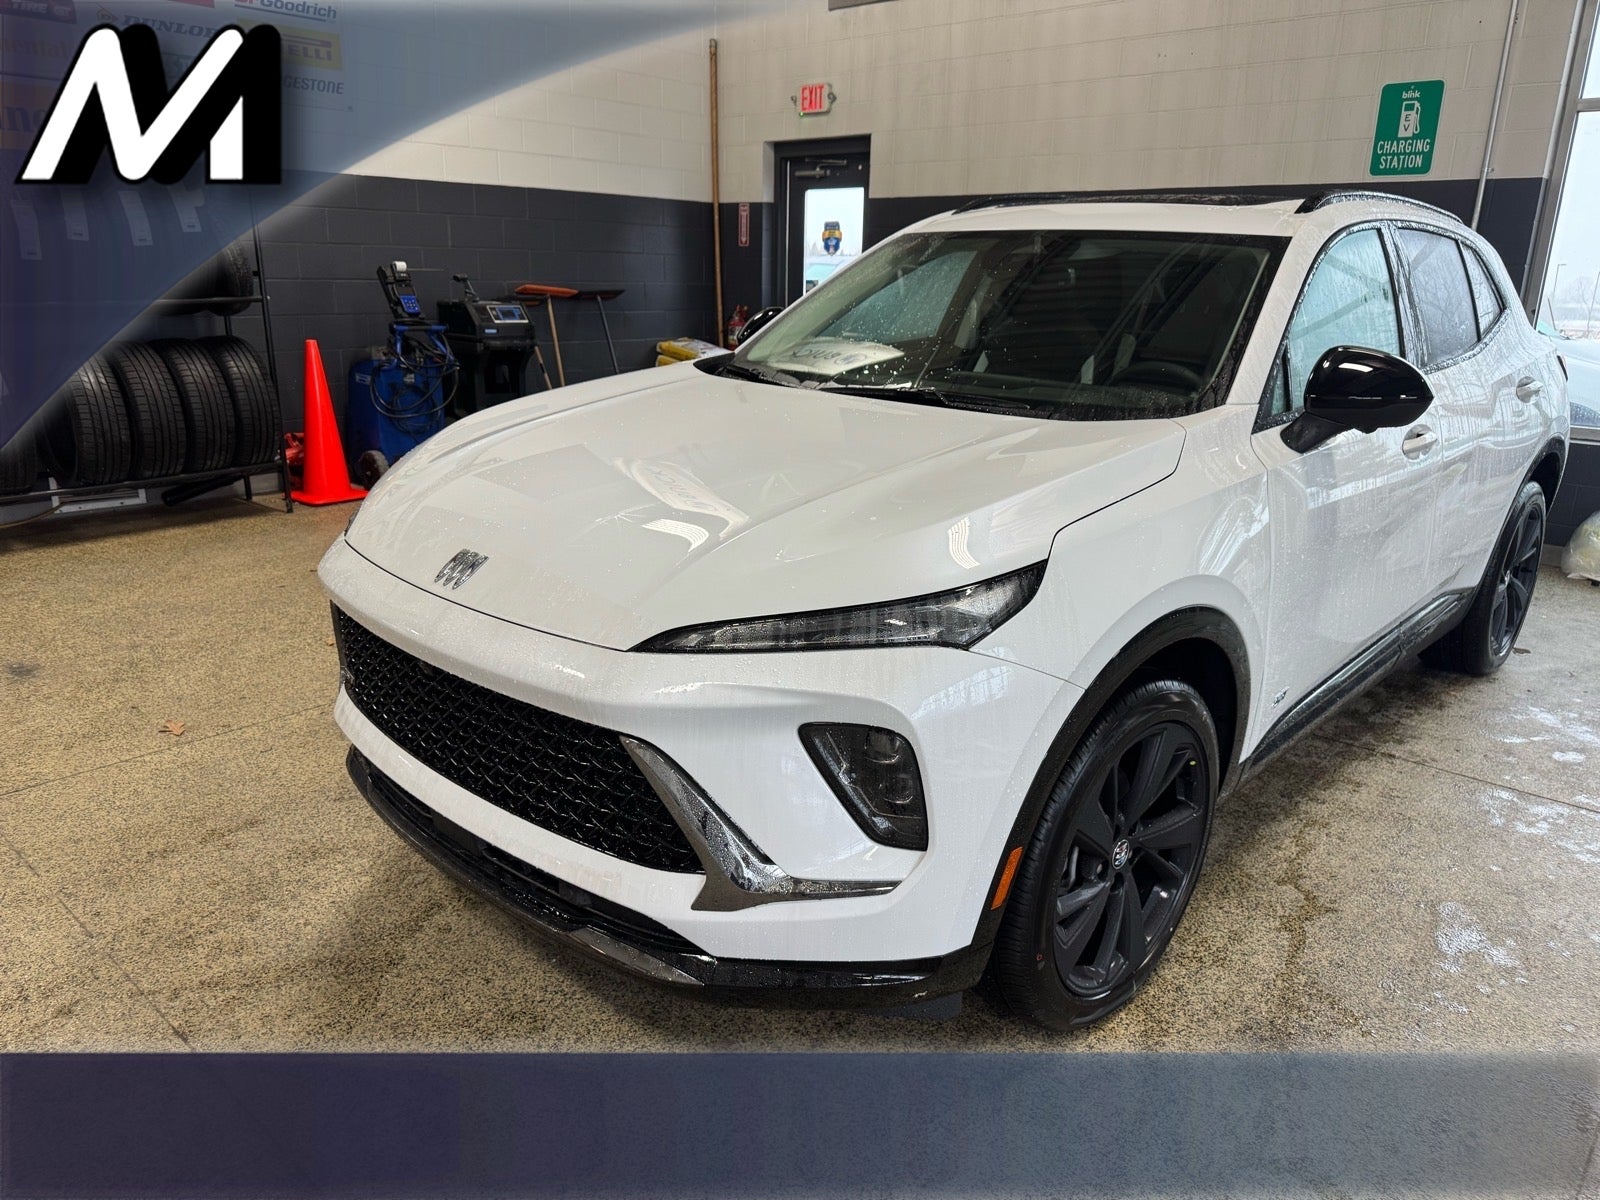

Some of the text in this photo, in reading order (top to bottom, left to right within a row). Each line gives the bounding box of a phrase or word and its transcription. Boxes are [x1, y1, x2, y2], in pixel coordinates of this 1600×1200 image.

[801, 85, 824, 111] EXIT
[1401, 90, 1421, 99] blink
[1377, 139, 1431, 154] CHARGING
[1379, 155, 1423, 169] STATION
